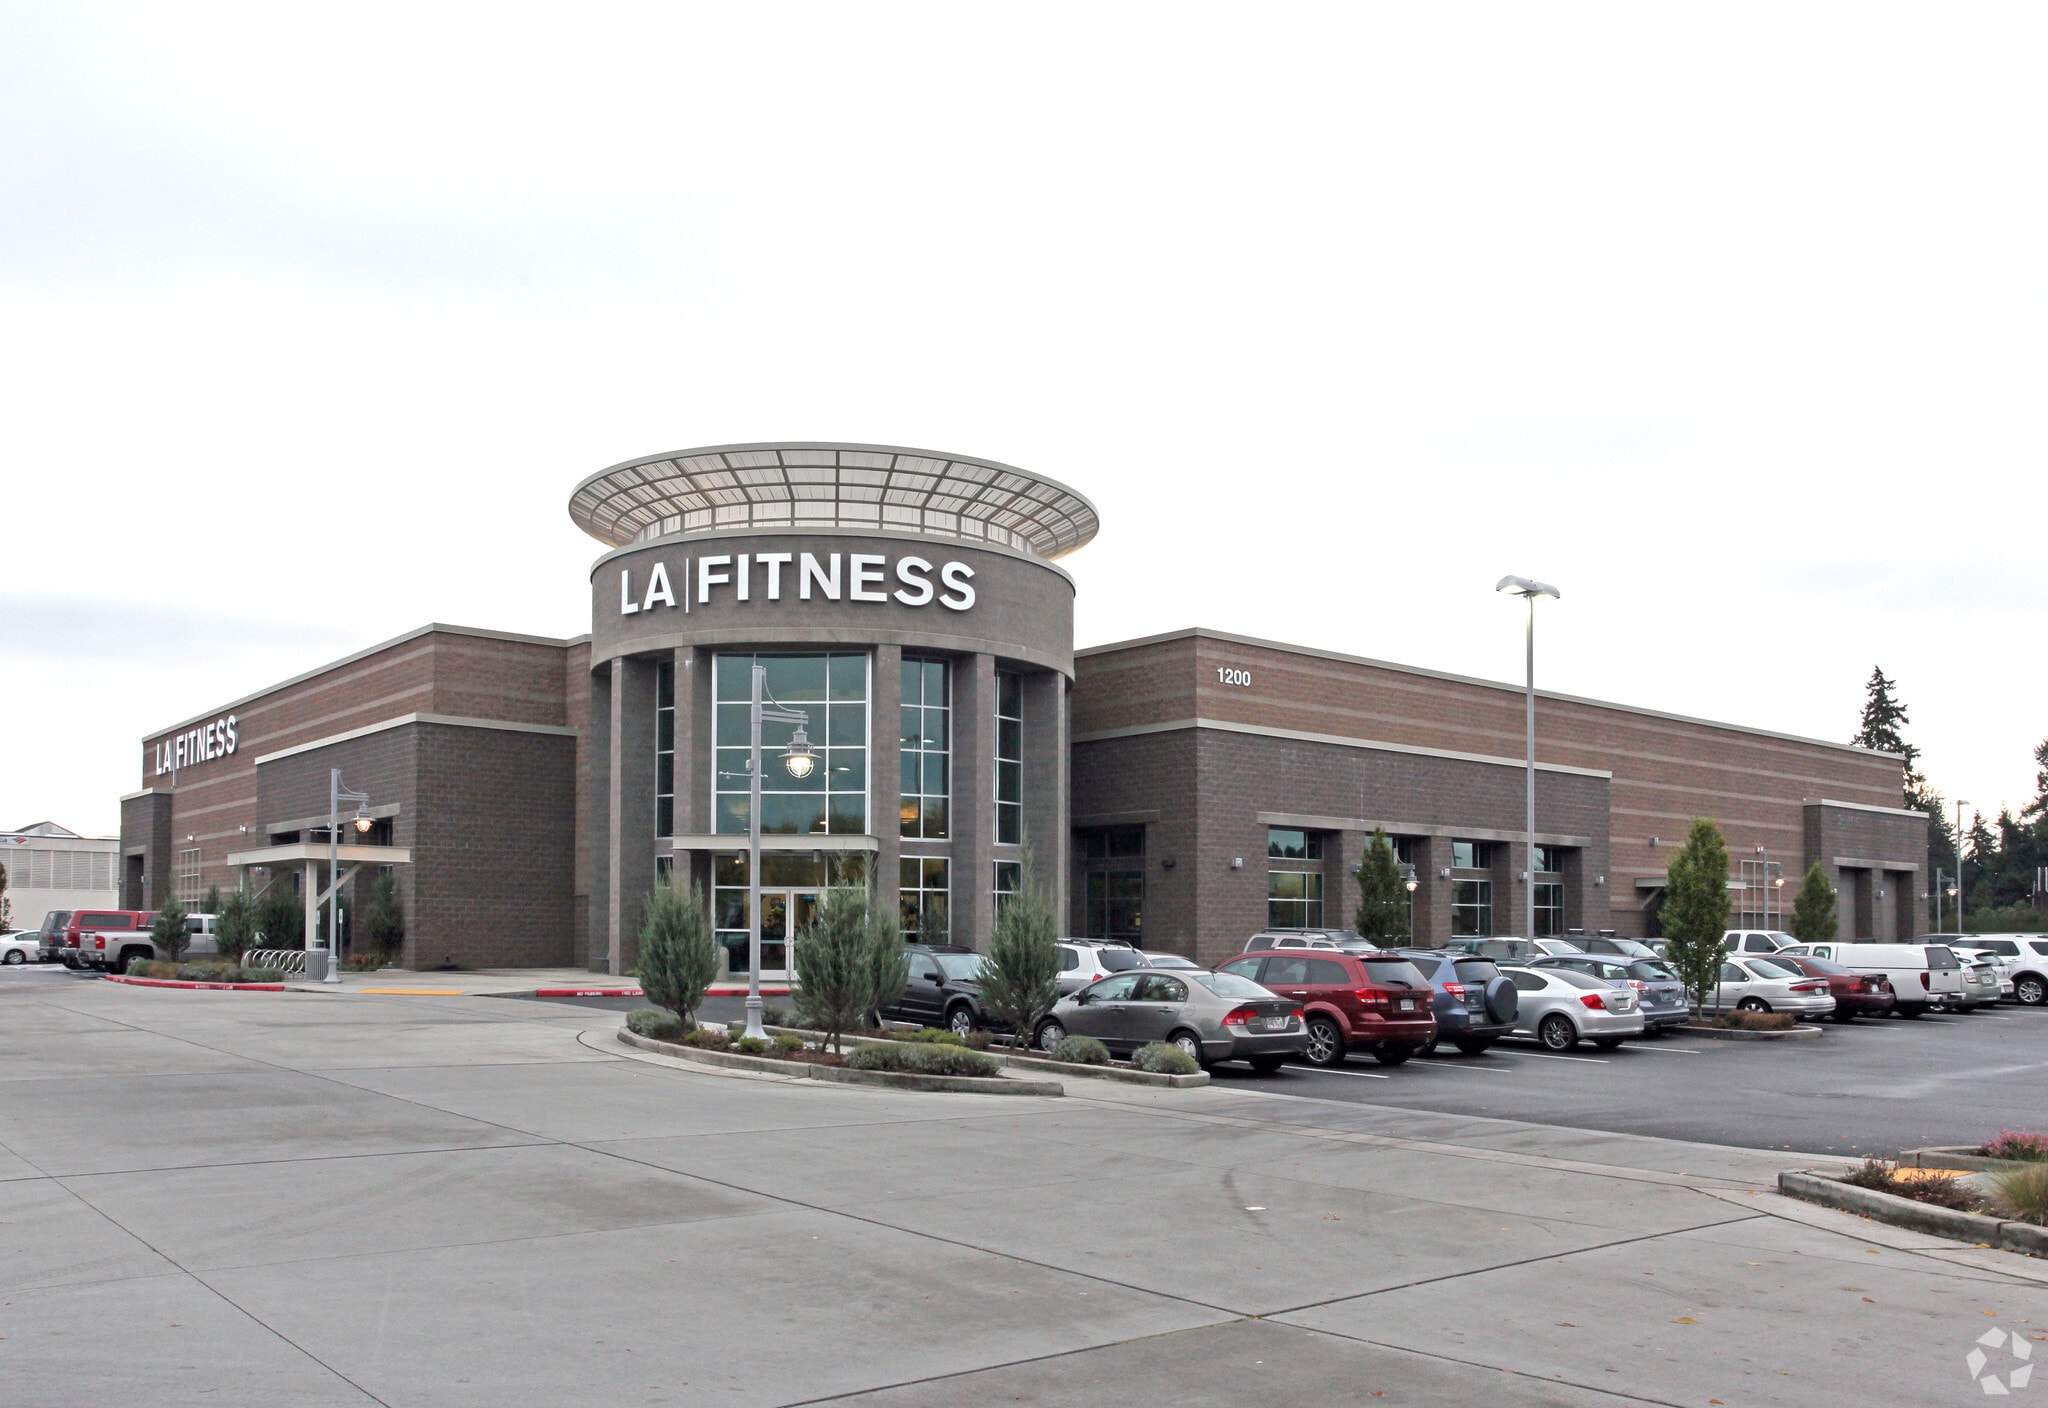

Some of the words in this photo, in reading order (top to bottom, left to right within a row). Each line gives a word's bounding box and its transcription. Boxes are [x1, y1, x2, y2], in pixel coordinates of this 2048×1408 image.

[621, 562, 676, 615] LA
[698, 553, 976, 611] FITNESS
[1217, 667, 1251, 687] 1200
[156, 740, 172, 775] LA
[176, 715, 236, 770] FITNESS
